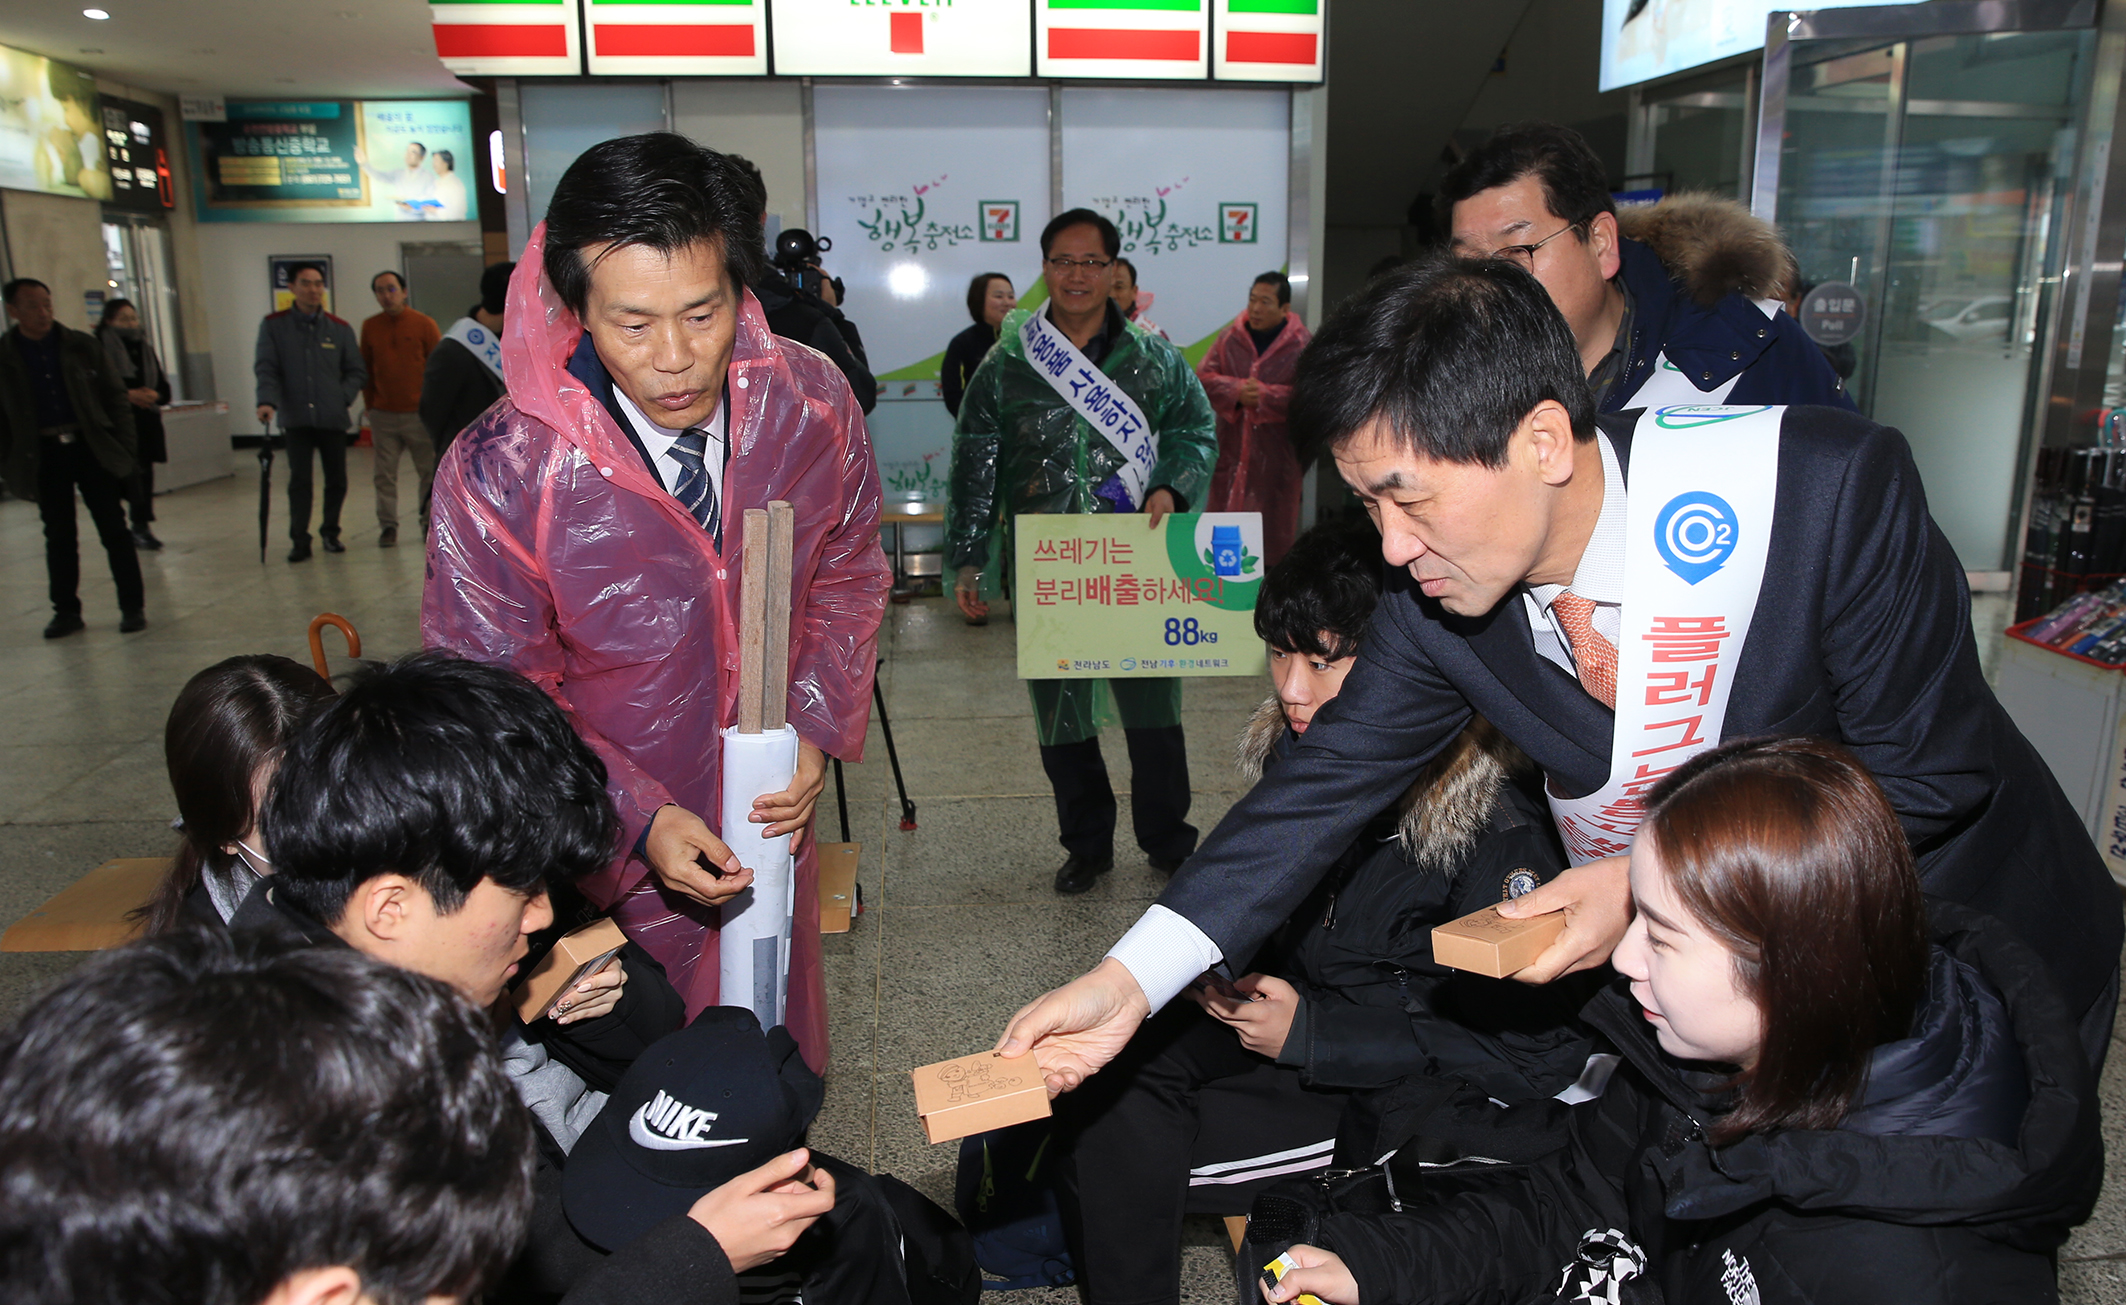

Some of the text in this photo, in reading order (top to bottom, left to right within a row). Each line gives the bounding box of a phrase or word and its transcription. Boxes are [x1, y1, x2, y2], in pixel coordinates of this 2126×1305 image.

[857, 197, 975, 255] 행복충전소
[1069, 368, 1143, 444] 사용하지
[1033, 537, 1133, 565] 쓰레기는
[1033, 573, 1225, 606] 분리배출하세요!
[1073, 659, 1111, 670] 전라남도
[644, 1089, 718, 1141] NIKE
